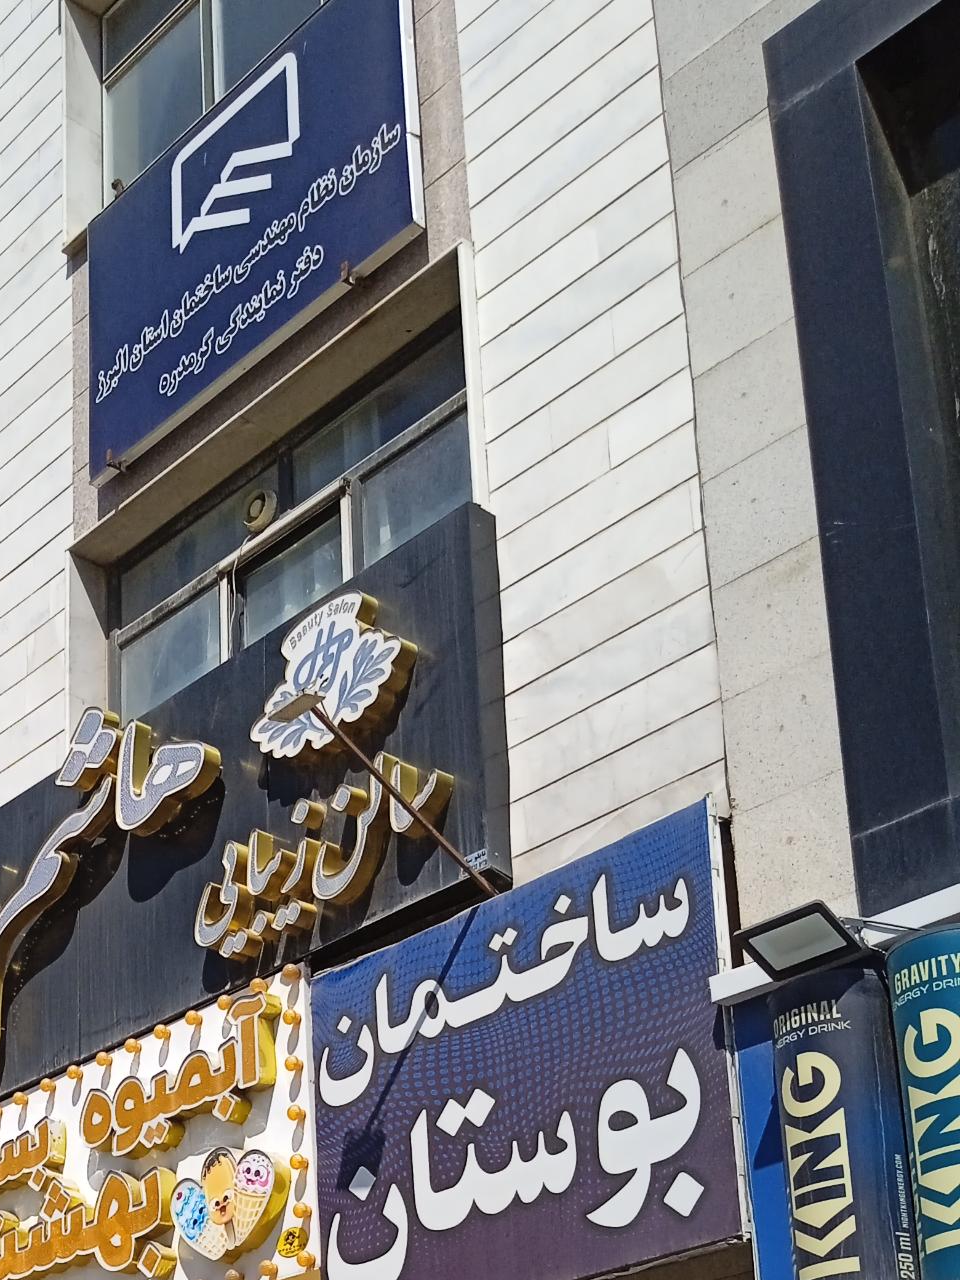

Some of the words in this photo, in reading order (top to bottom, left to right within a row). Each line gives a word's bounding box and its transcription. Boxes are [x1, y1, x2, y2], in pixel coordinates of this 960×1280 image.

[339, 123, 402, 195] سازمان
[298, 168, 337, 232] نظام
[234, 212, 296, 285] مهندسی
[286, 244, 324, 299] دفتر
[170, 264, 232, 337] ساختمان
[215, 270, 287, 354] نمایندگی
[130, 310, 169, 372] استان
[96, 344, 129, 404] البرز
[326, 598, 357, 619] Salon
[318, 873, 691, 1107] ساختمان
[773, 999, 843, 1038] ORIGINAL
[808, 1020, 852, 1036] DRINK
[78, 991, 266, 1158] آبمیوه
[897, 1253, 916, 1280] 250
